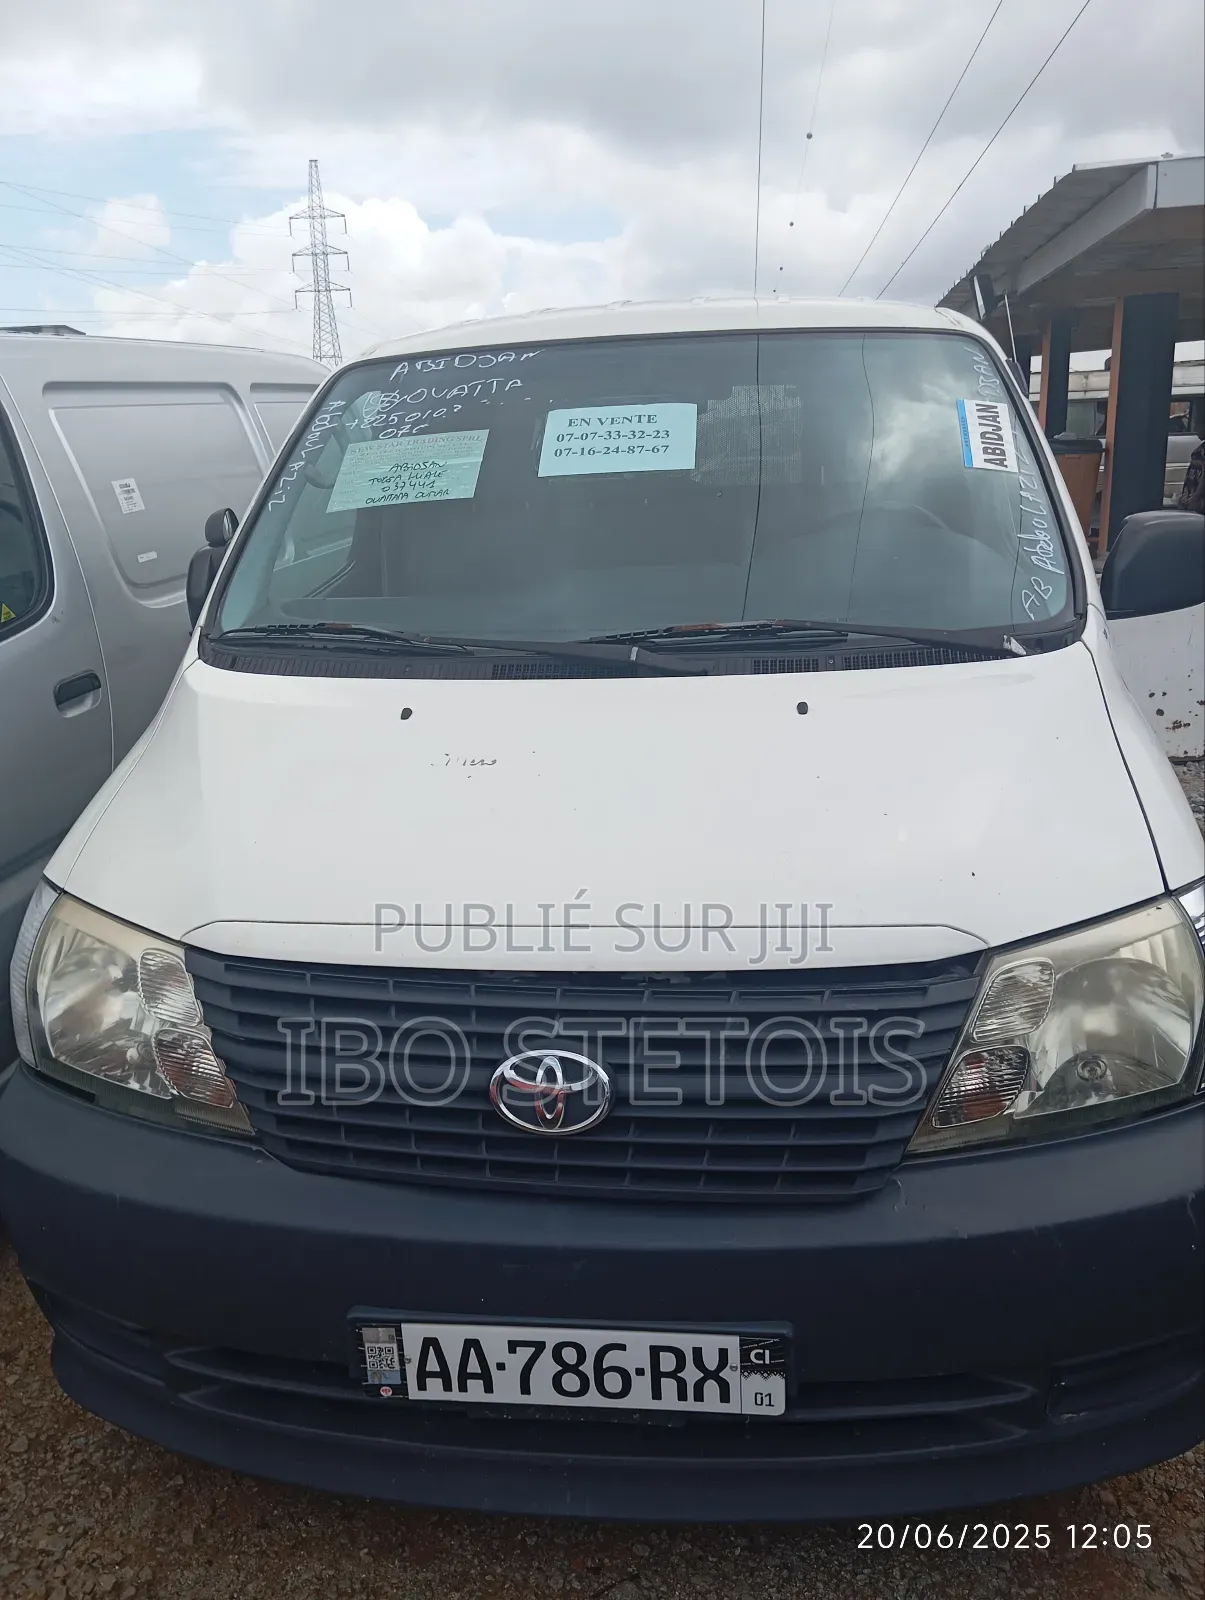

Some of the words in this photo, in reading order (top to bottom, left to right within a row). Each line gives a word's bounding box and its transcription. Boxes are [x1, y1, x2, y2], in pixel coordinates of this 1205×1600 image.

[567, 418, 592, 428] EN
[597, 414, 658, 426] VENTE
[406, 435, 455, 446] TRADING
[556, 430, 670, 443] 07-07-33-32-23
[975, 403, 1008, 469] ABIDJAN
[554, 445, 670, 458] 07-16-24-87-67
[749, 1348, 770, 1365] CI
[754, 1392, 775, 1407] 01
